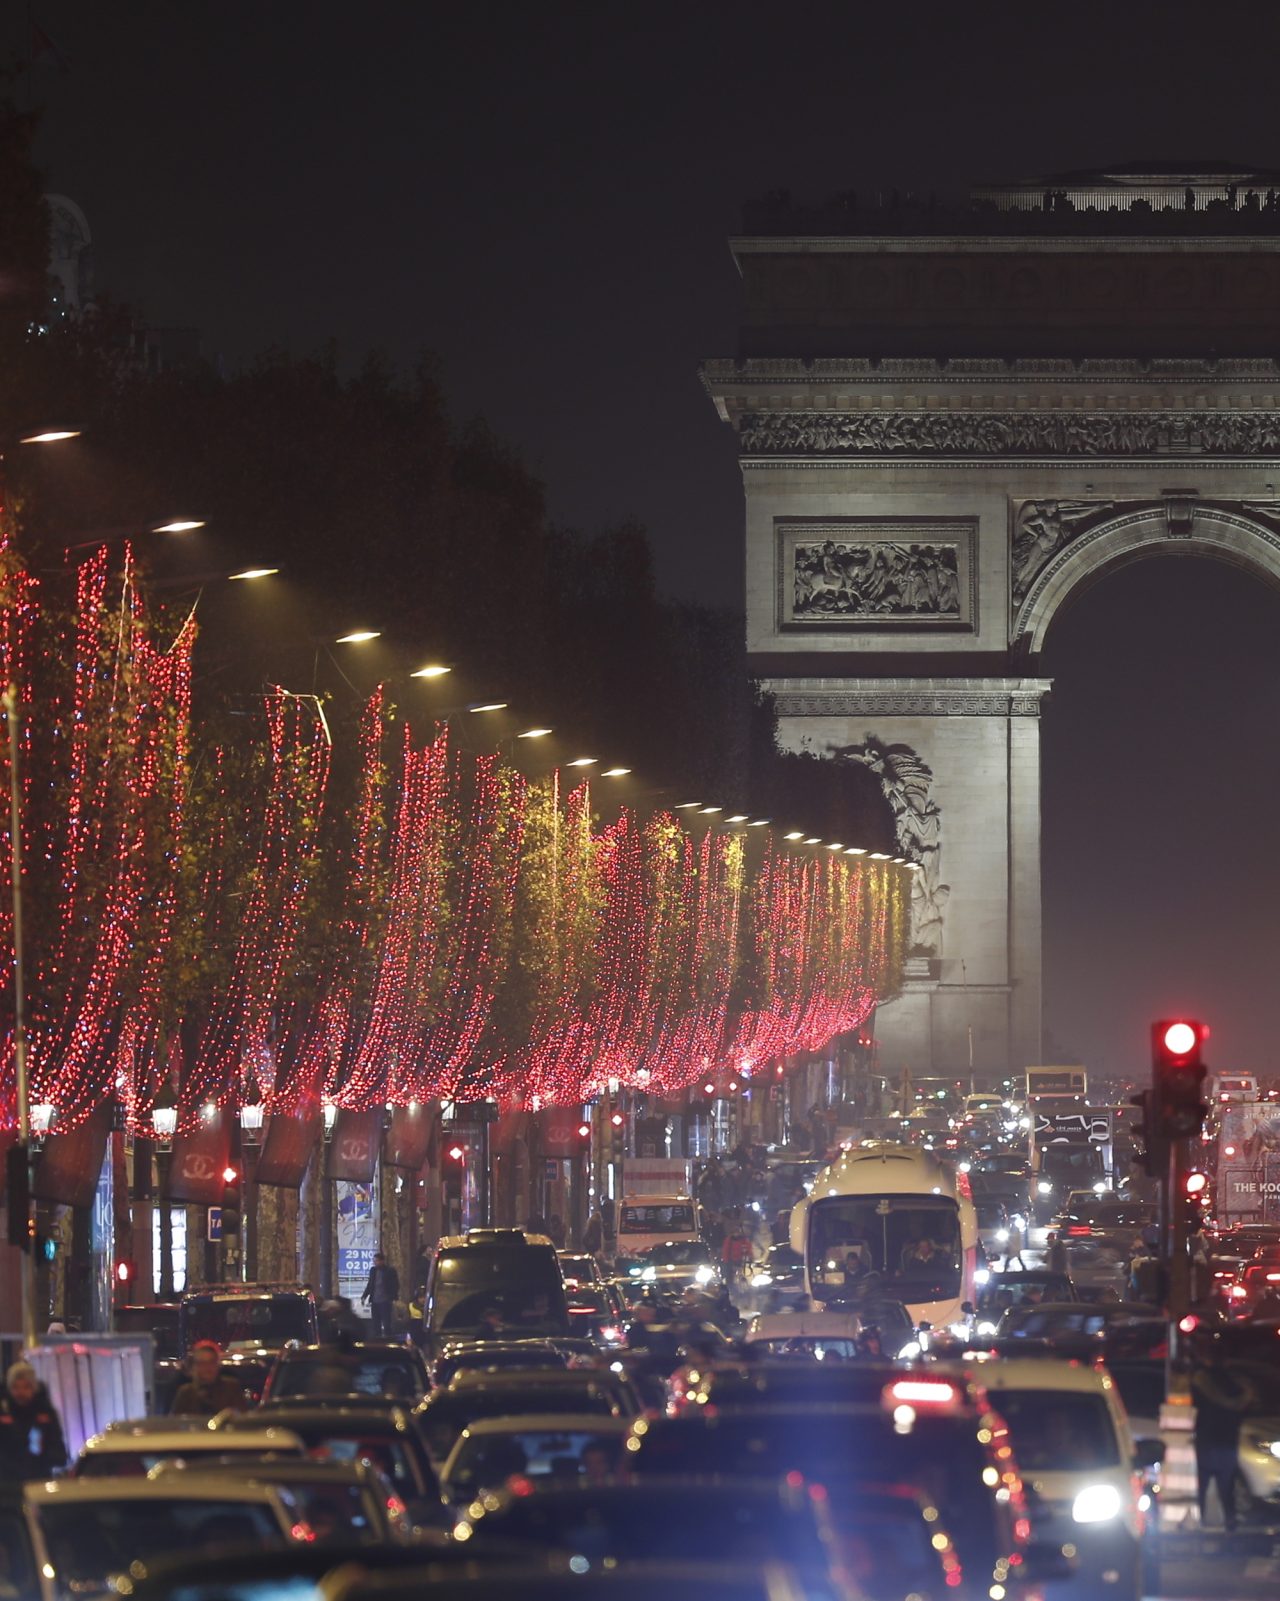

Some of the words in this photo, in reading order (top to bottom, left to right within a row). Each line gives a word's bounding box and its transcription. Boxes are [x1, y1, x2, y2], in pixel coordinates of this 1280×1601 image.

[1233, 1182, 1257, 1193] THE
[211, 1218, 222, 1229] TA
[345, 1250, 358, 1259] 29
[361, 1250, 374, 1259] NO
[346, 1261, 360, 1270] 02
